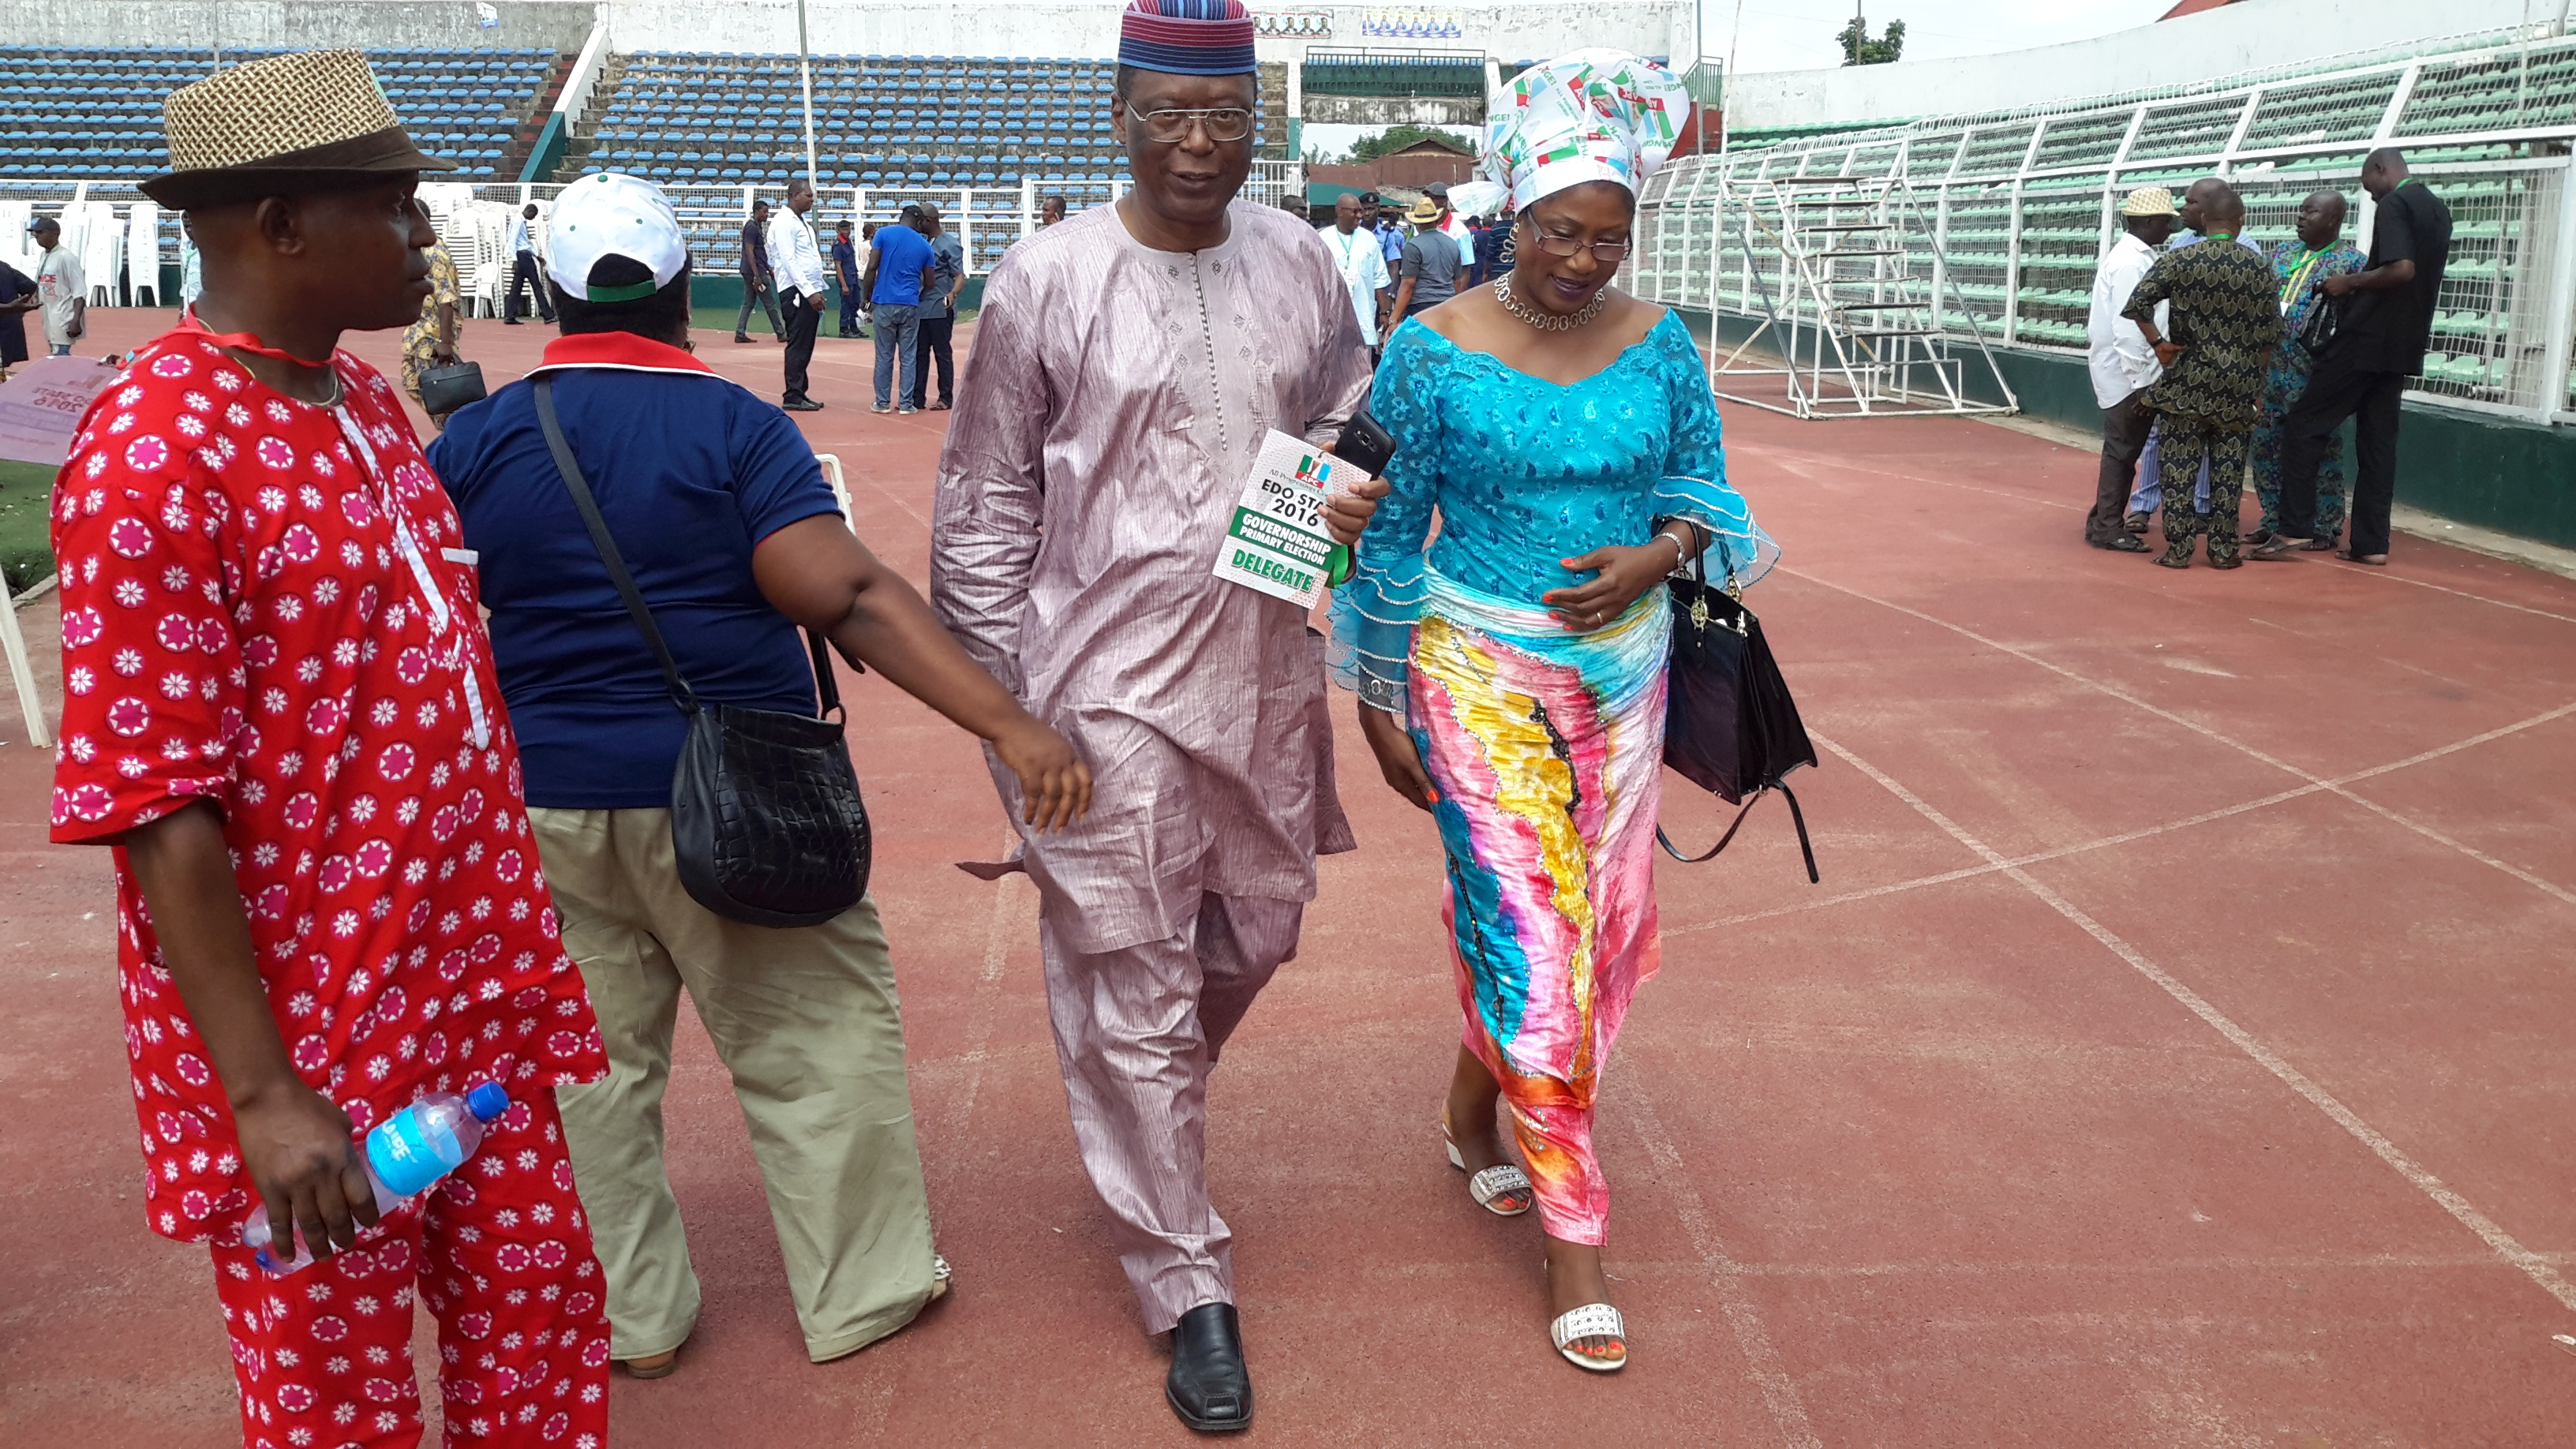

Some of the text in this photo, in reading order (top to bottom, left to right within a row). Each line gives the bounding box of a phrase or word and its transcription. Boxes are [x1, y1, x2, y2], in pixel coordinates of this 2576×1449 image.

[1261, 478, 1294, 499] EDO
[1301, 475, 1320, 486] APC
[1271, 498, 1319, 526] 2016
[1240, 526, 1326, 566] PRIMARY ELECTION
[1242, 513, 1331, 555] GOVERNORSHIP
[1231, 549, 1316, 593] DELEGATE
